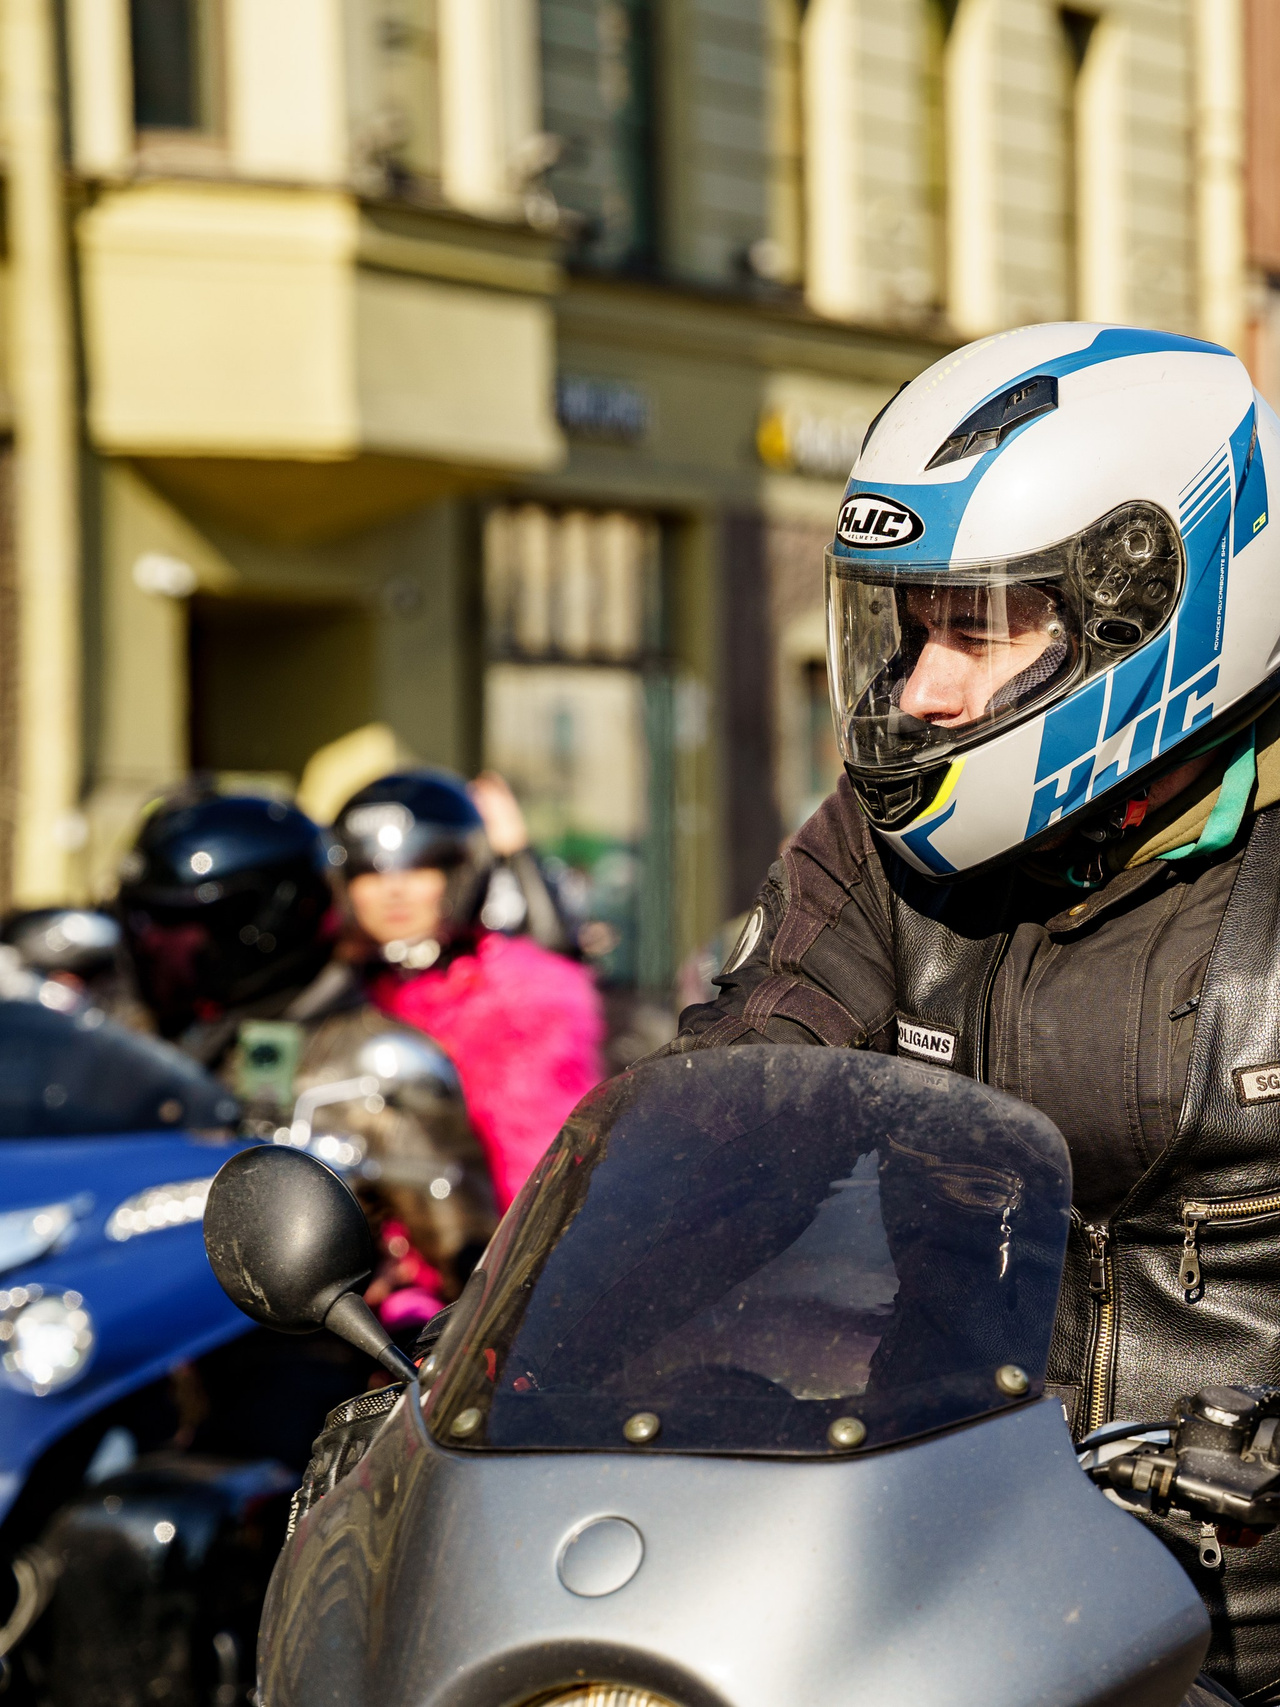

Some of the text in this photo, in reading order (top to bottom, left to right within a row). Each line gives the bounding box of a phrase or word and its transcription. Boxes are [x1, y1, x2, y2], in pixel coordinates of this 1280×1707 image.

[839, 507, 907, 537] HJC
[1217, 559, 1225, 615] POLYCARBONATE
[1023, 663, 1220, 841] HJC
